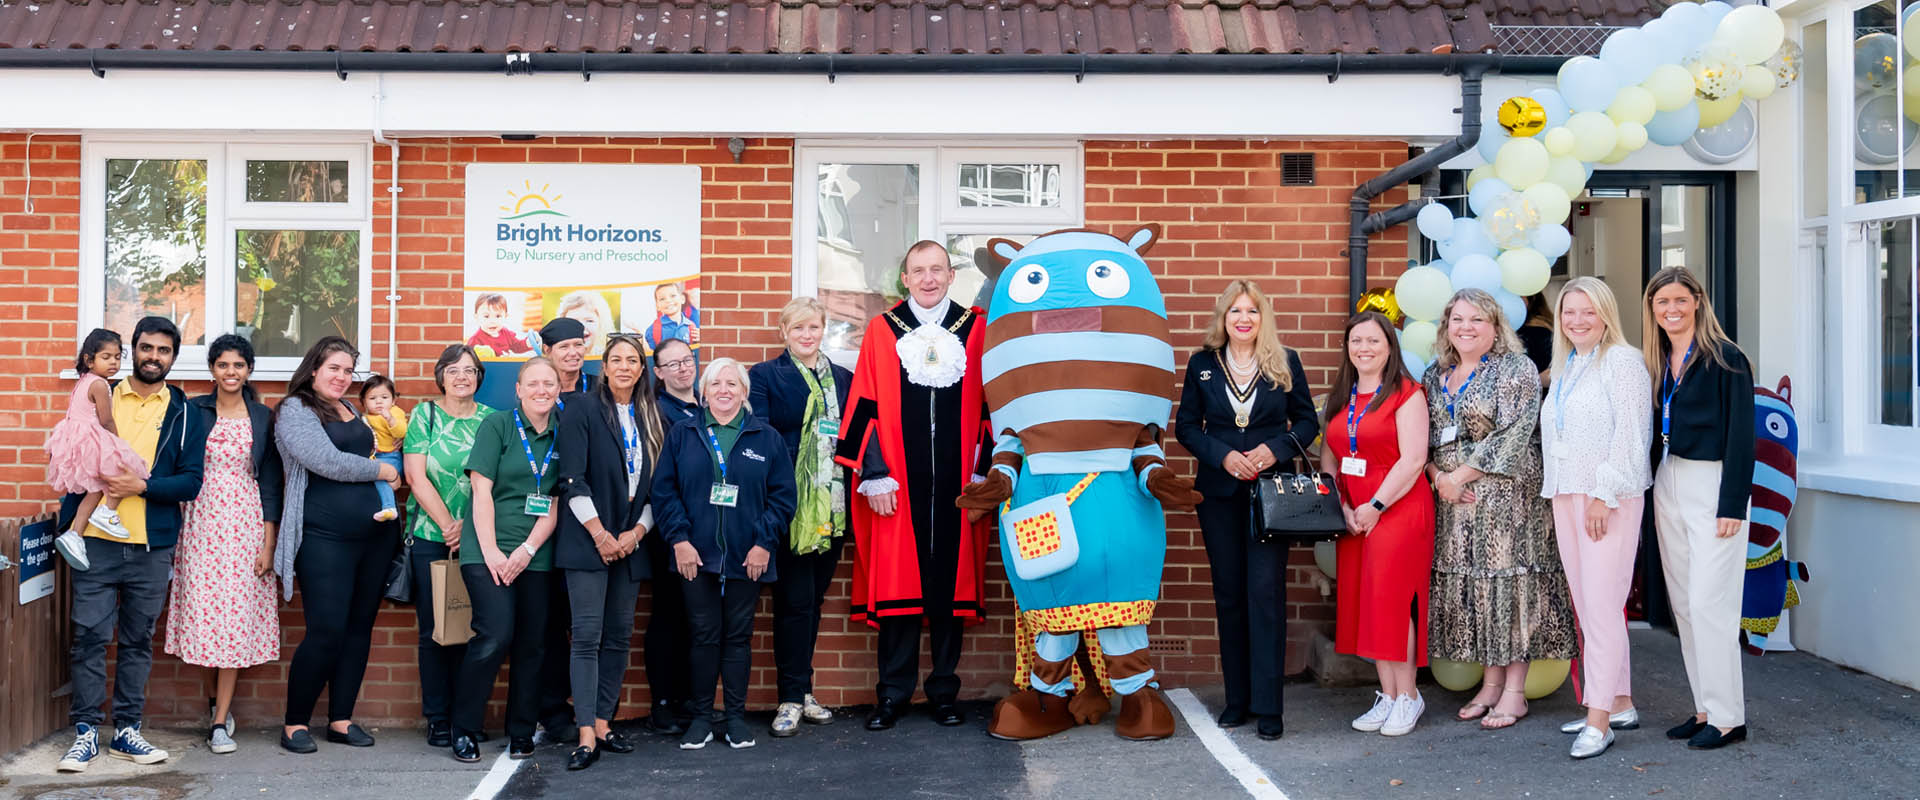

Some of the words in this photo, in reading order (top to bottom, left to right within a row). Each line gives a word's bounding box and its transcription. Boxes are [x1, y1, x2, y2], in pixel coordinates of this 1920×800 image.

[496, 223, 562, 247] Bright
[567, 224, 662, 242] Horizons
[496, 248, 521, 263] Day
[525, 248, 575, 264] Nursery
[578, 249, 602, 261] and
[606, 249, 668, 262] Preschool
[22, 537, 39, 551] Please
[40, 532, 53, 546] close
[27, 552, 36, 566] the
[36, 550, 48, 566] gate
